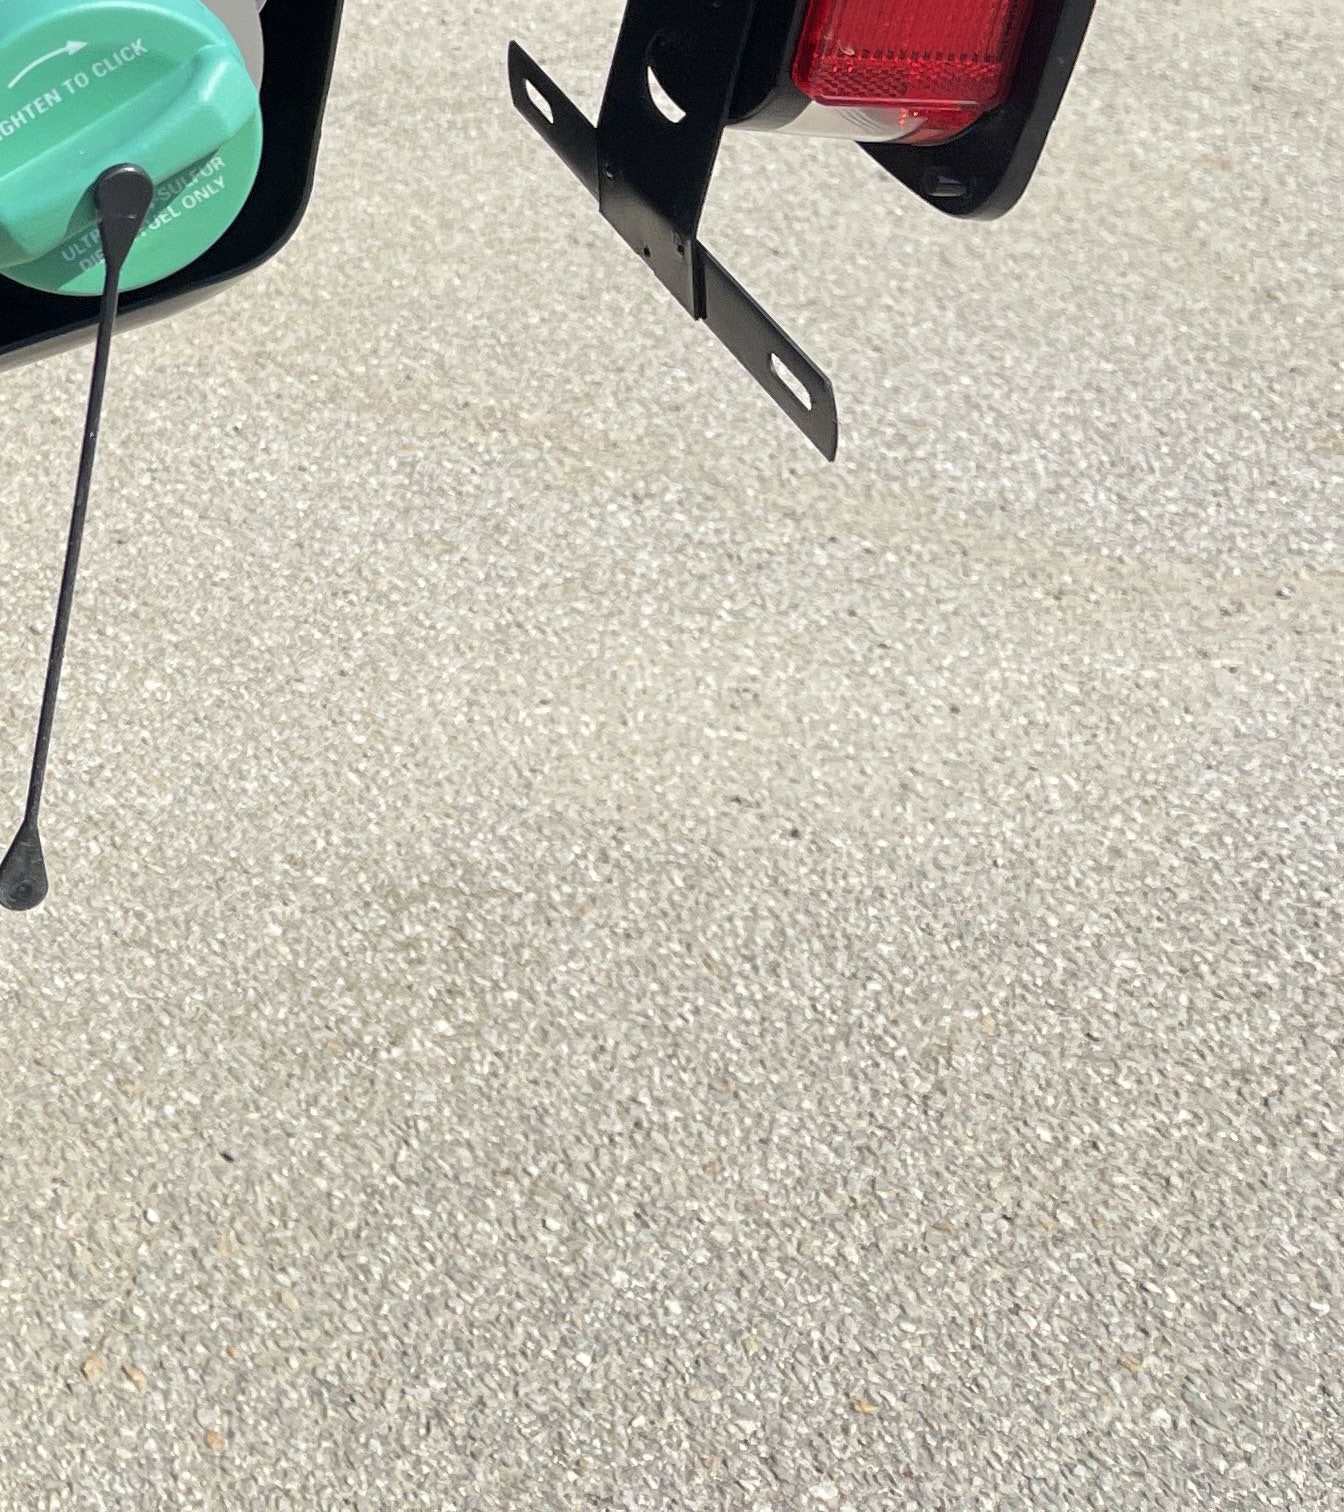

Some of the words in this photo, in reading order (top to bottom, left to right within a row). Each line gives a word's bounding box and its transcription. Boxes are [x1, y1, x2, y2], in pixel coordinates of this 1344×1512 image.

[62, 72, 89, 94] TO
[91, 38, 149, 78] CLICK
[181, 175, 226, 209] ONLY
[62, 228, 101, 262] ULTR
